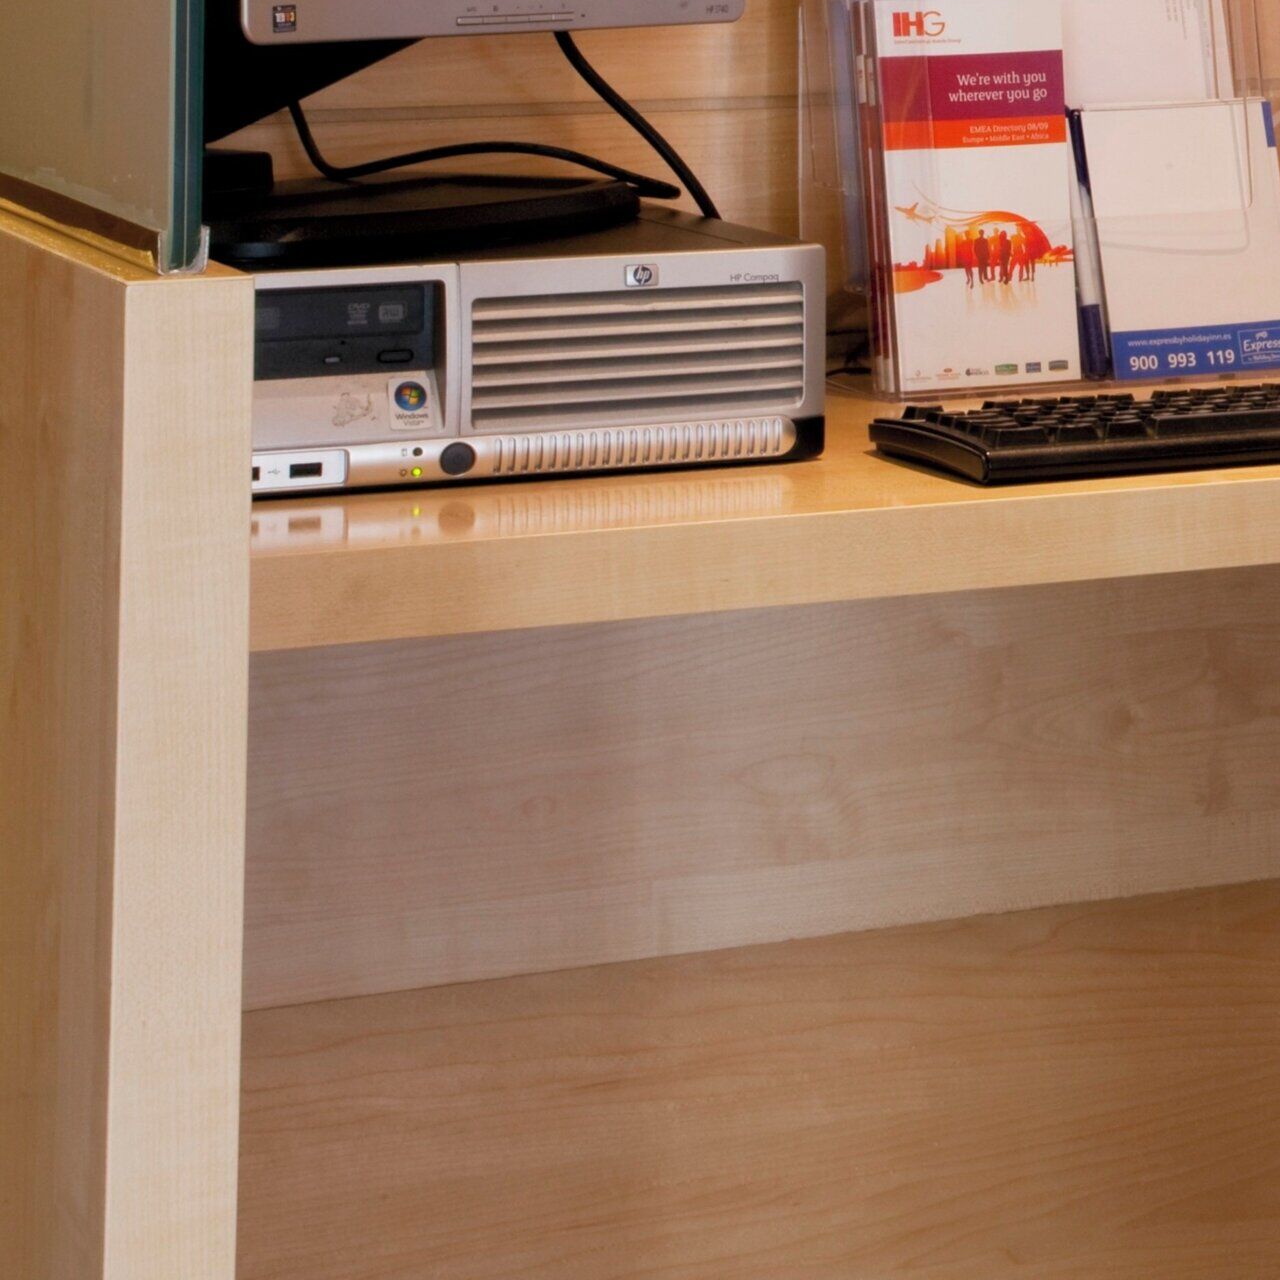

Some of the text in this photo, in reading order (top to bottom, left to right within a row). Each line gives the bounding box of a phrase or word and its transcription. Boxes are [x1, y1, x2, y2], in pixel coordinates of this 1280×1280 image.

[892, 11, 946, 37] IHG
[957, 71, 1047, 86] We're with you
[948, 88, 1048, 103] wherever you go
[969, 125, 992, 134] EMEA
[993, 124, 1026, 133] Directory
[730, 273, 779, 283] HP Compaq
[1127, 333, 1232, 348] www.expressbyholidayinn.es
[1130, 350, 1235, 371] 900 993 119
